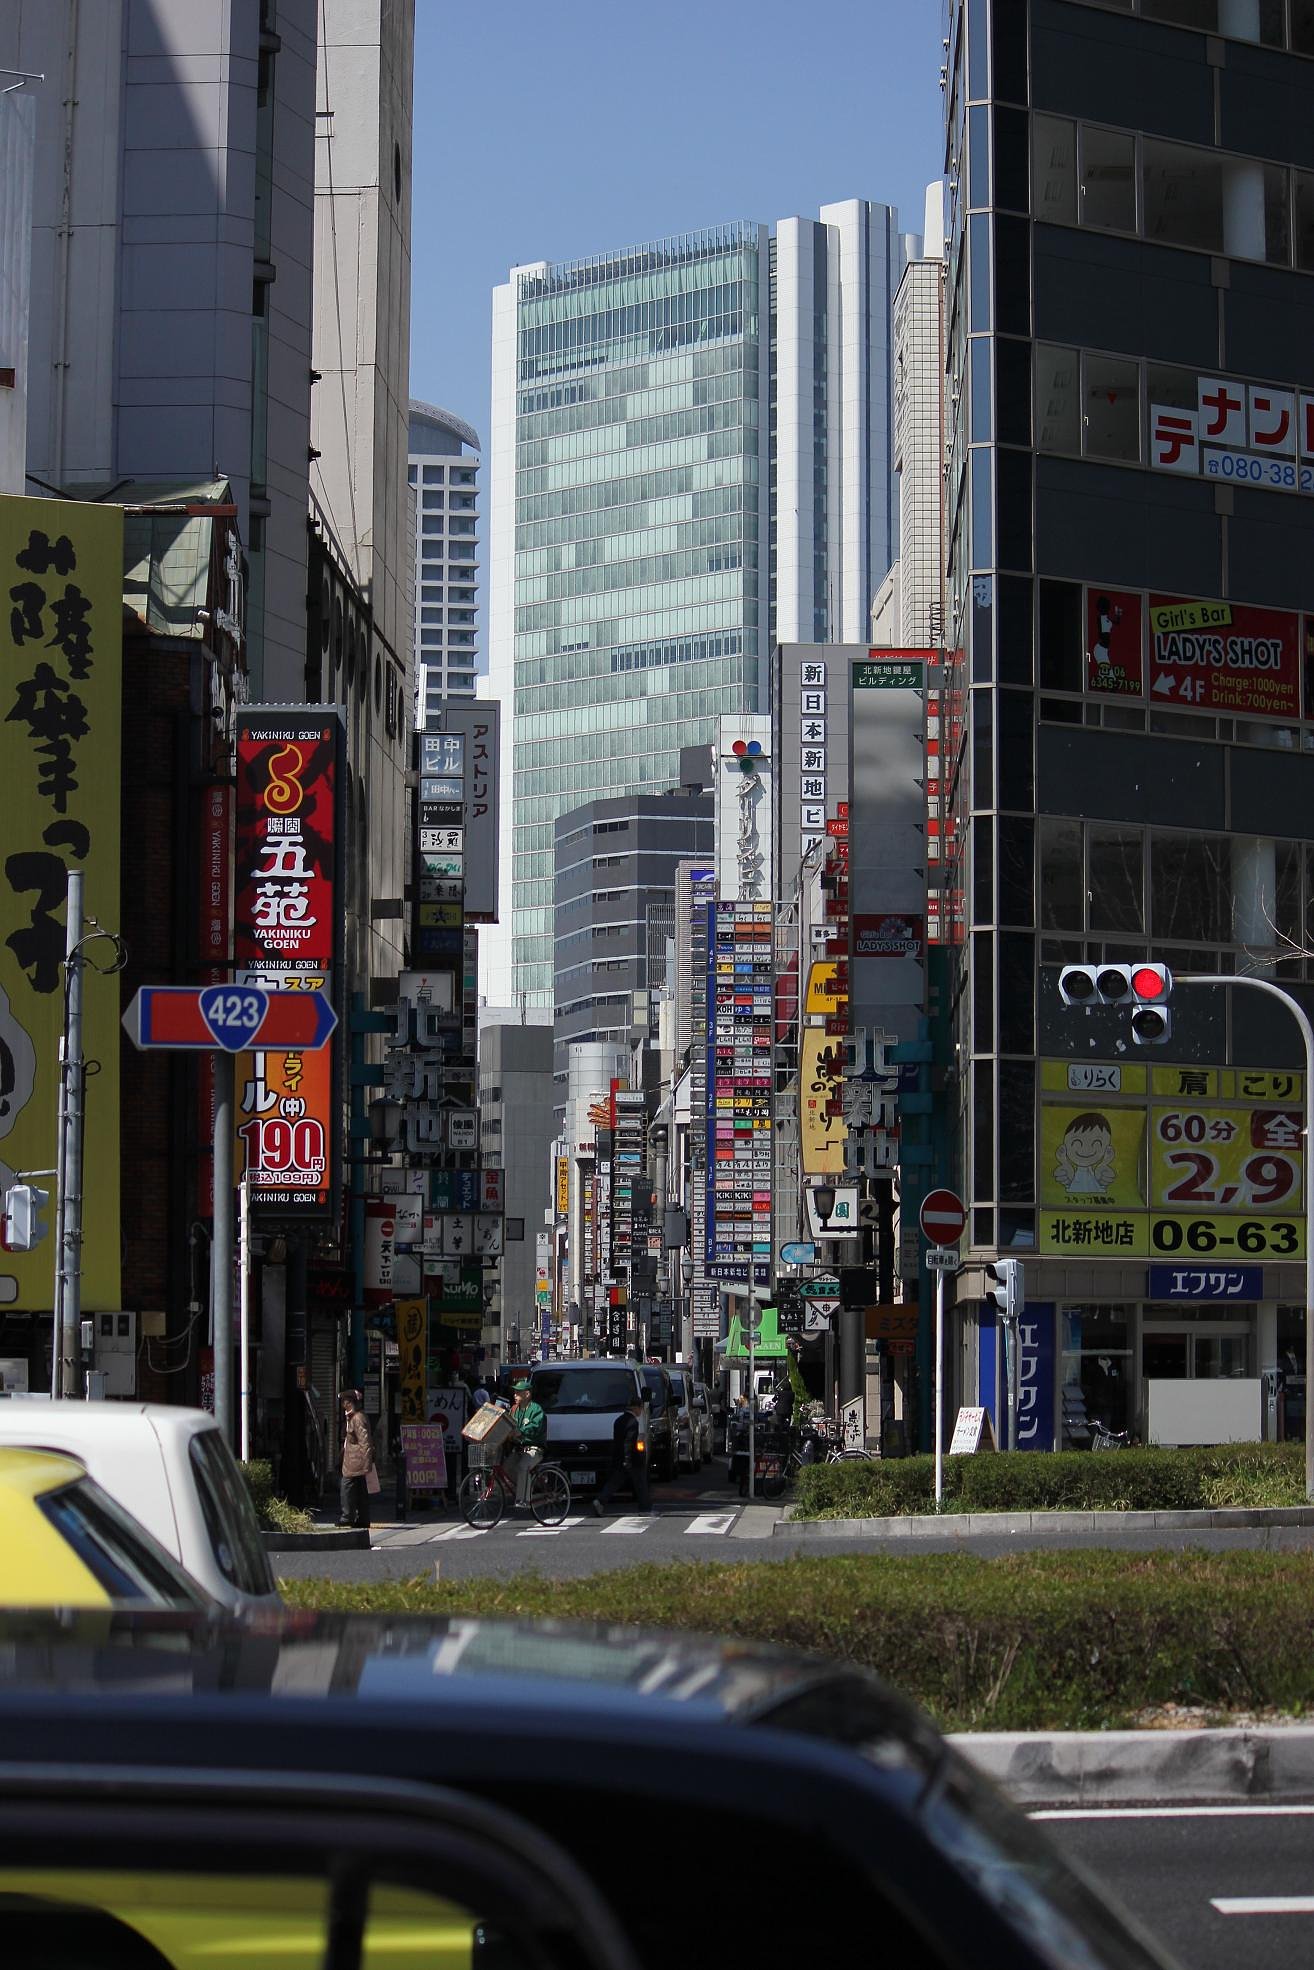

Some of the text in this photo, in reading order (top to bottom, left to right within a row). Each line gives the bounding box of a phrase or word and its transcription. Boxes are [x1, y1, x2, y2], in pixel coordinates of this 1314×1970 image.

[1157, 607, 1227, 628] Girl's Bar
[1156, 635, 1281, 669] LADY'S SHOT
[858, 677, 917, 685] ビルディング
[1179, 676, 1206, 702] 4F
[251, 731, 321, 740] YAKINIKU GOEN
[425, 738, 460, 752] 田中
[425, 757, 460, 771] ビル
[473, 725, 488, 818] アストリア
[250, 835, 317, 927] 五苑
[253, 929, 311, 939] YAKINIKU
[264, 940, 300, 949] GOEN
[248, 960, 318, 969] YAKINIKU GOEN
[208, 995, 260, 1028] 423
[1084, 1070, 1116, 1089] りらく
[1178, 1071, 1209, 1096] 肩
[1243, 1076, 1294, 1098] こり
[842, 1026, 899, 1179] 北新地
[1160, 1113, 1236, 1143] 60分
[1263, 1114, 1301, 1148] 全
[293, 1192, 316, 1202] GOEN
[1050, 1219, 1135, 1247] 北新地店
[1153, 1220, 1299, 1253] 06-63
[379, 1240, 392, 1285] 天下一品
[1170, 1271, 1246, 1295] エフワン
